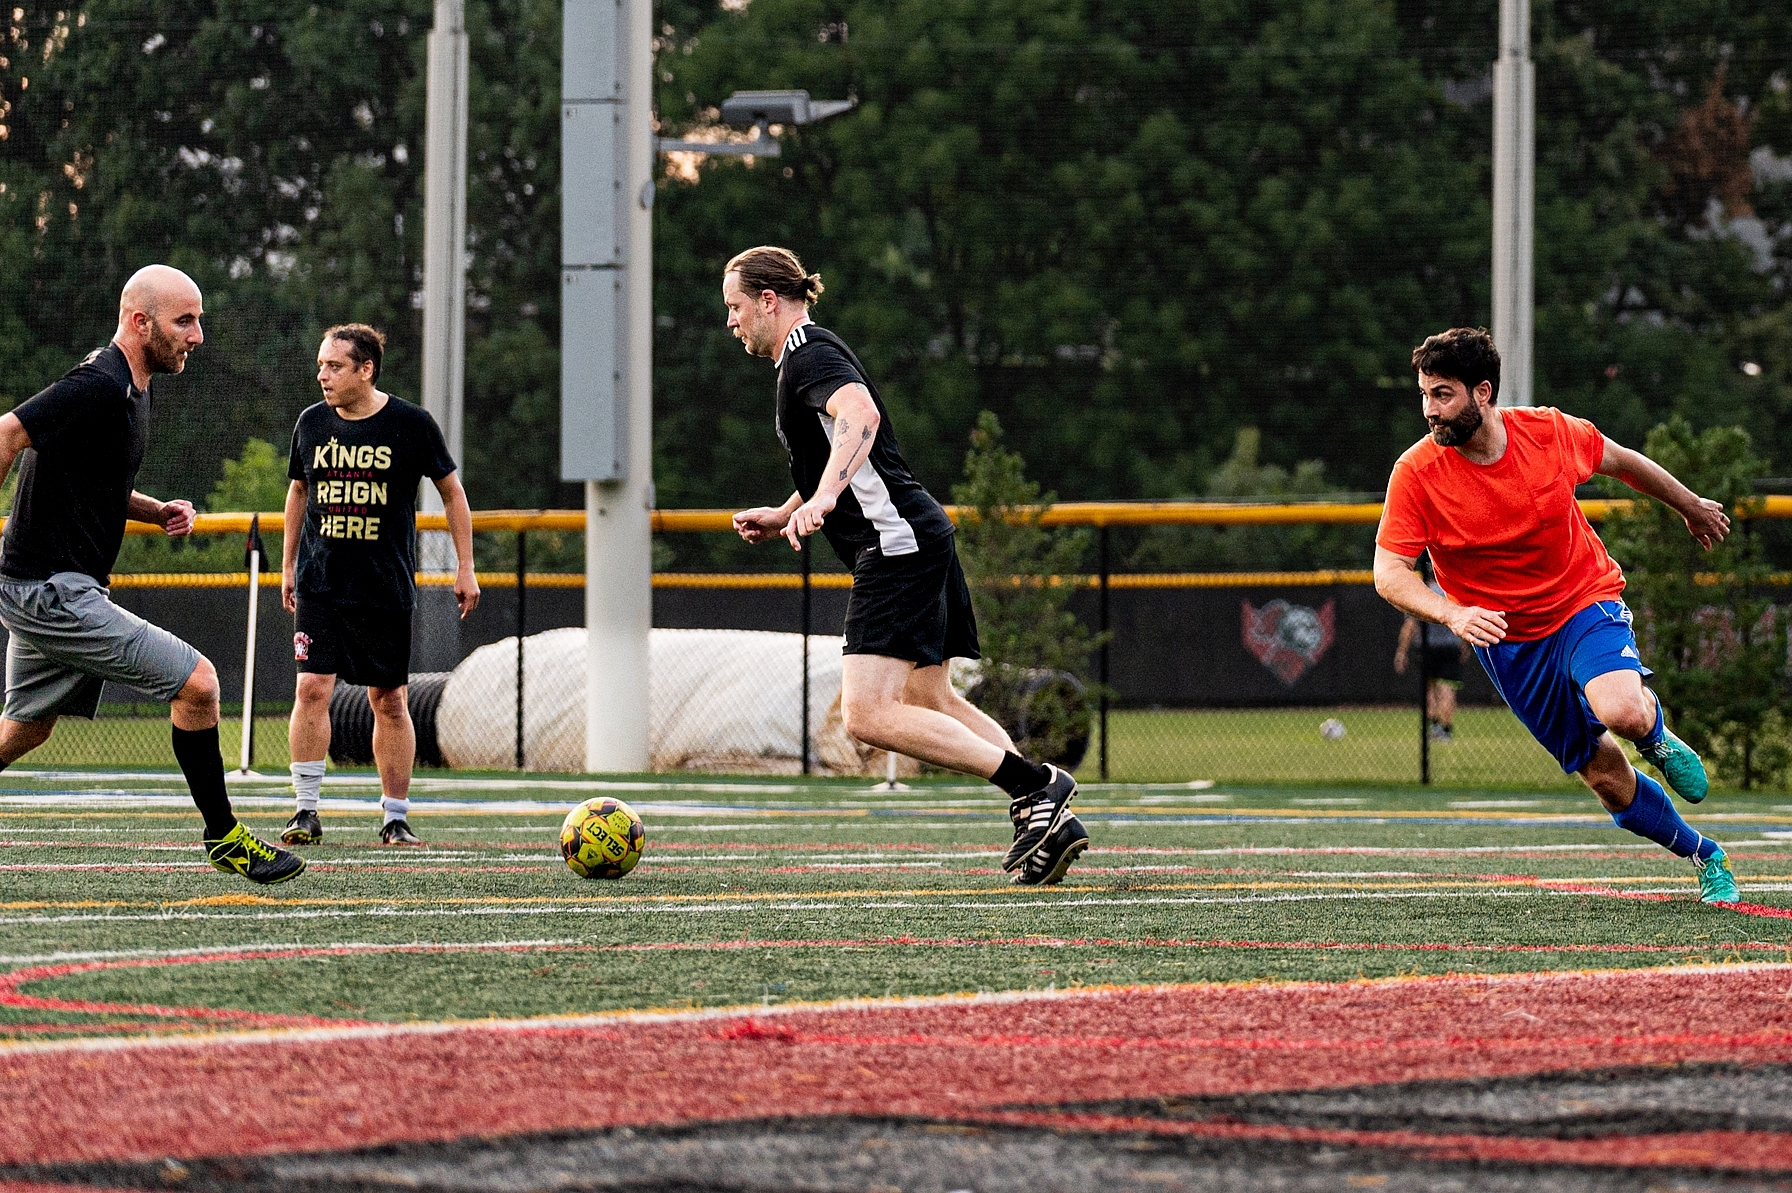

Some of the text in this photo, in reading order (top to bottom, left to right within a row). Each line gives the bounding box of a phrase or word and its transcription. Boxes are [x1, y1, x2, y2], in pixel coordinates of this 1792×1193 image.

[313, 438, 392, 469] KINGS
[326, 470, 373, 479] ATLANTA
[317, 480, 388, 505] REIGN
[328, 506, 368, 515] UNITED
[319, 515, 381, 541] HERE
[586, 822, 625, 857] SELECT
